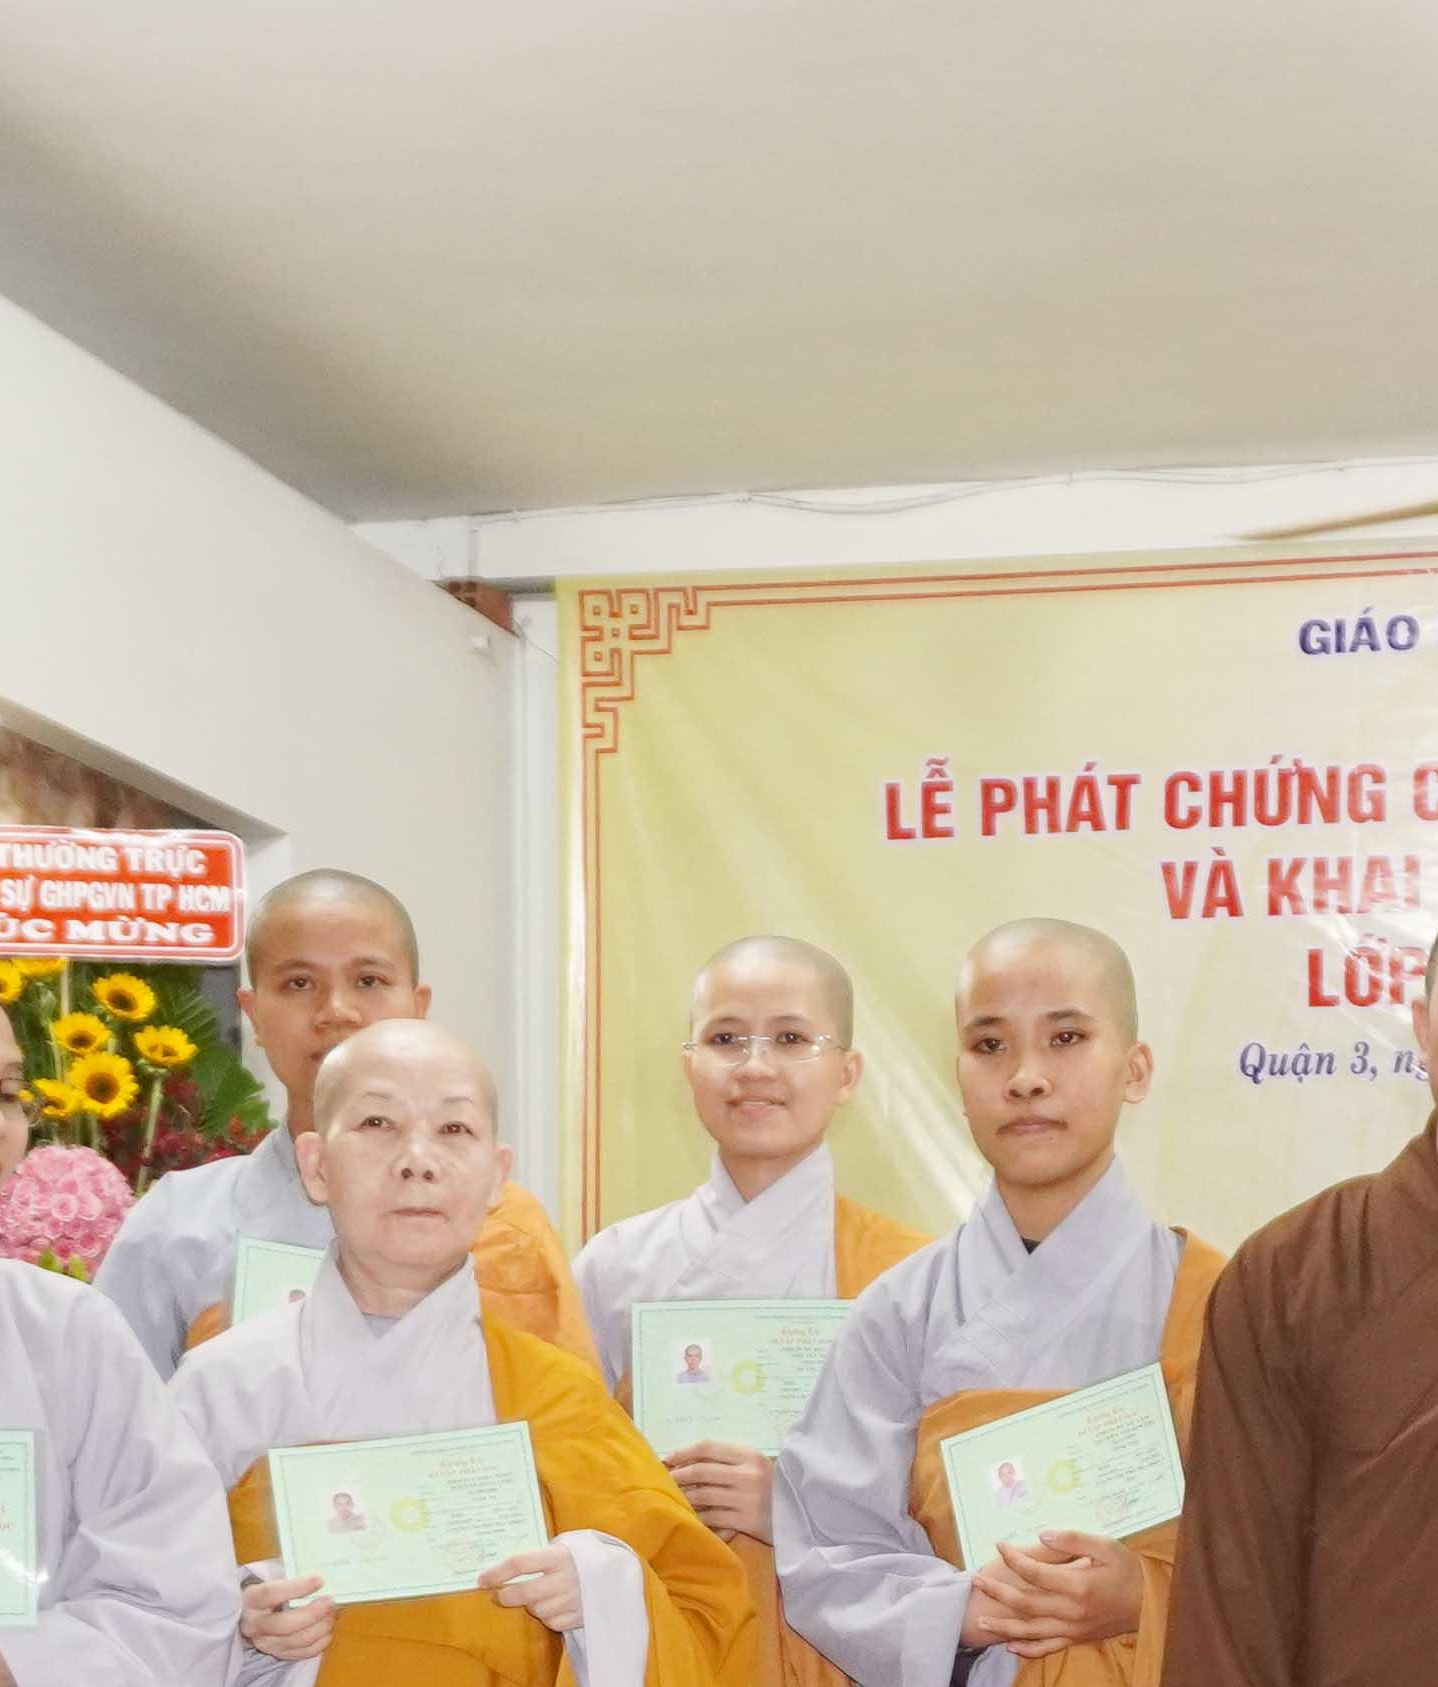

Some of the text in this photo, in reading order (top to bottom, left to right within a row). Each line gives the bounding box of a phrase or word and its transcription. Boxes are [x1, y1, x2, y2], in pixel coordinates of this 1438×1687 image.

[1298, 606, 1420, 656] GIÁO
[884, 757, 955, 840] LỄ
[979, 761, 1141, 837] PHÁT
[1163, 754, 1387, 829] CHỨNG
[123, 844, 208, 880] TRỰC
[1161, 847, 1244, 919] VÀ
[1267, 853, 1422, 916] KHAI
[0, 874, 35, 913] SỰ
[38, 879, 136, 911] GHPGVN
[139, 882, 173, 912] TP
[177, 884, 231, 913] HCM
[65, 915, 215, 944] MỪNG
[1240, 1042, 1336, 1084] Quận
[1350, 1041, 1377, 1079] 3,
